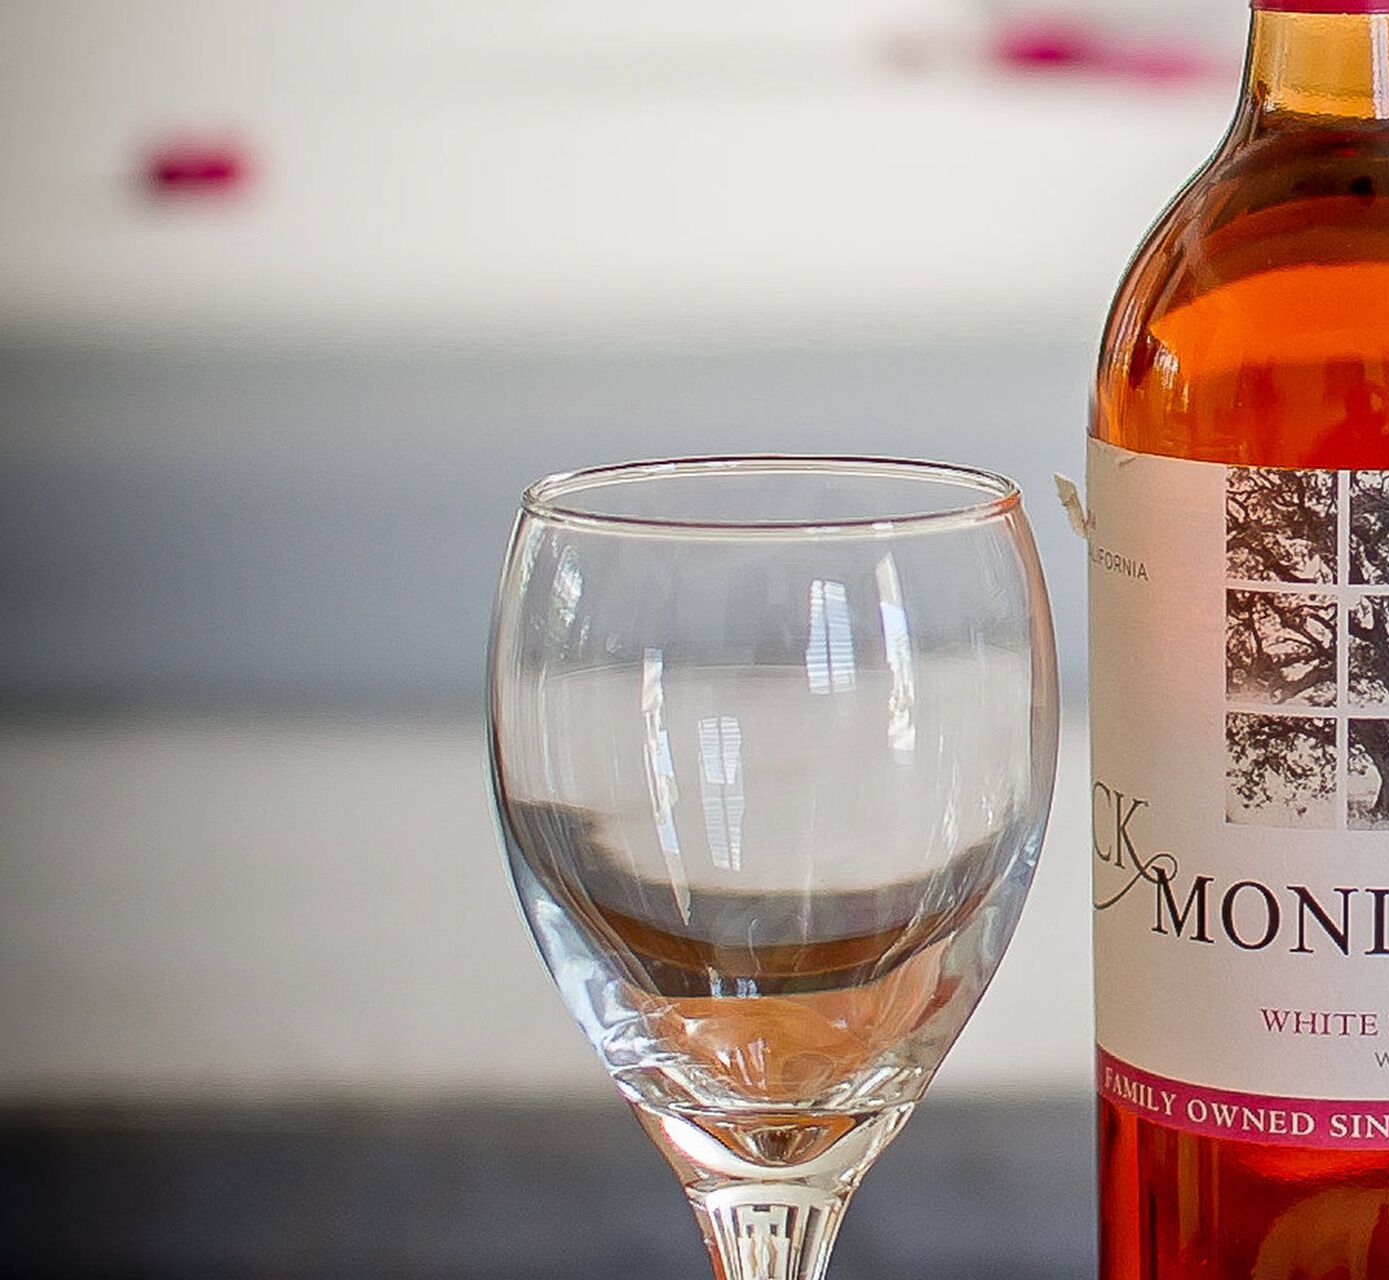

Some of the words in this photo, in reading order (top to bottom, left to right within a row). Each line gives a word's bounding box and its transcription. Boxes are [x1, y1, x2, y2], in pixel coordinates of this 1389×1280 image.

[1260, 1008, 1380, 1037] WHITE
[1104, 1066, 1177, 1117] FAMILY
[1187, 1098, 1316, 1137] OWNED
